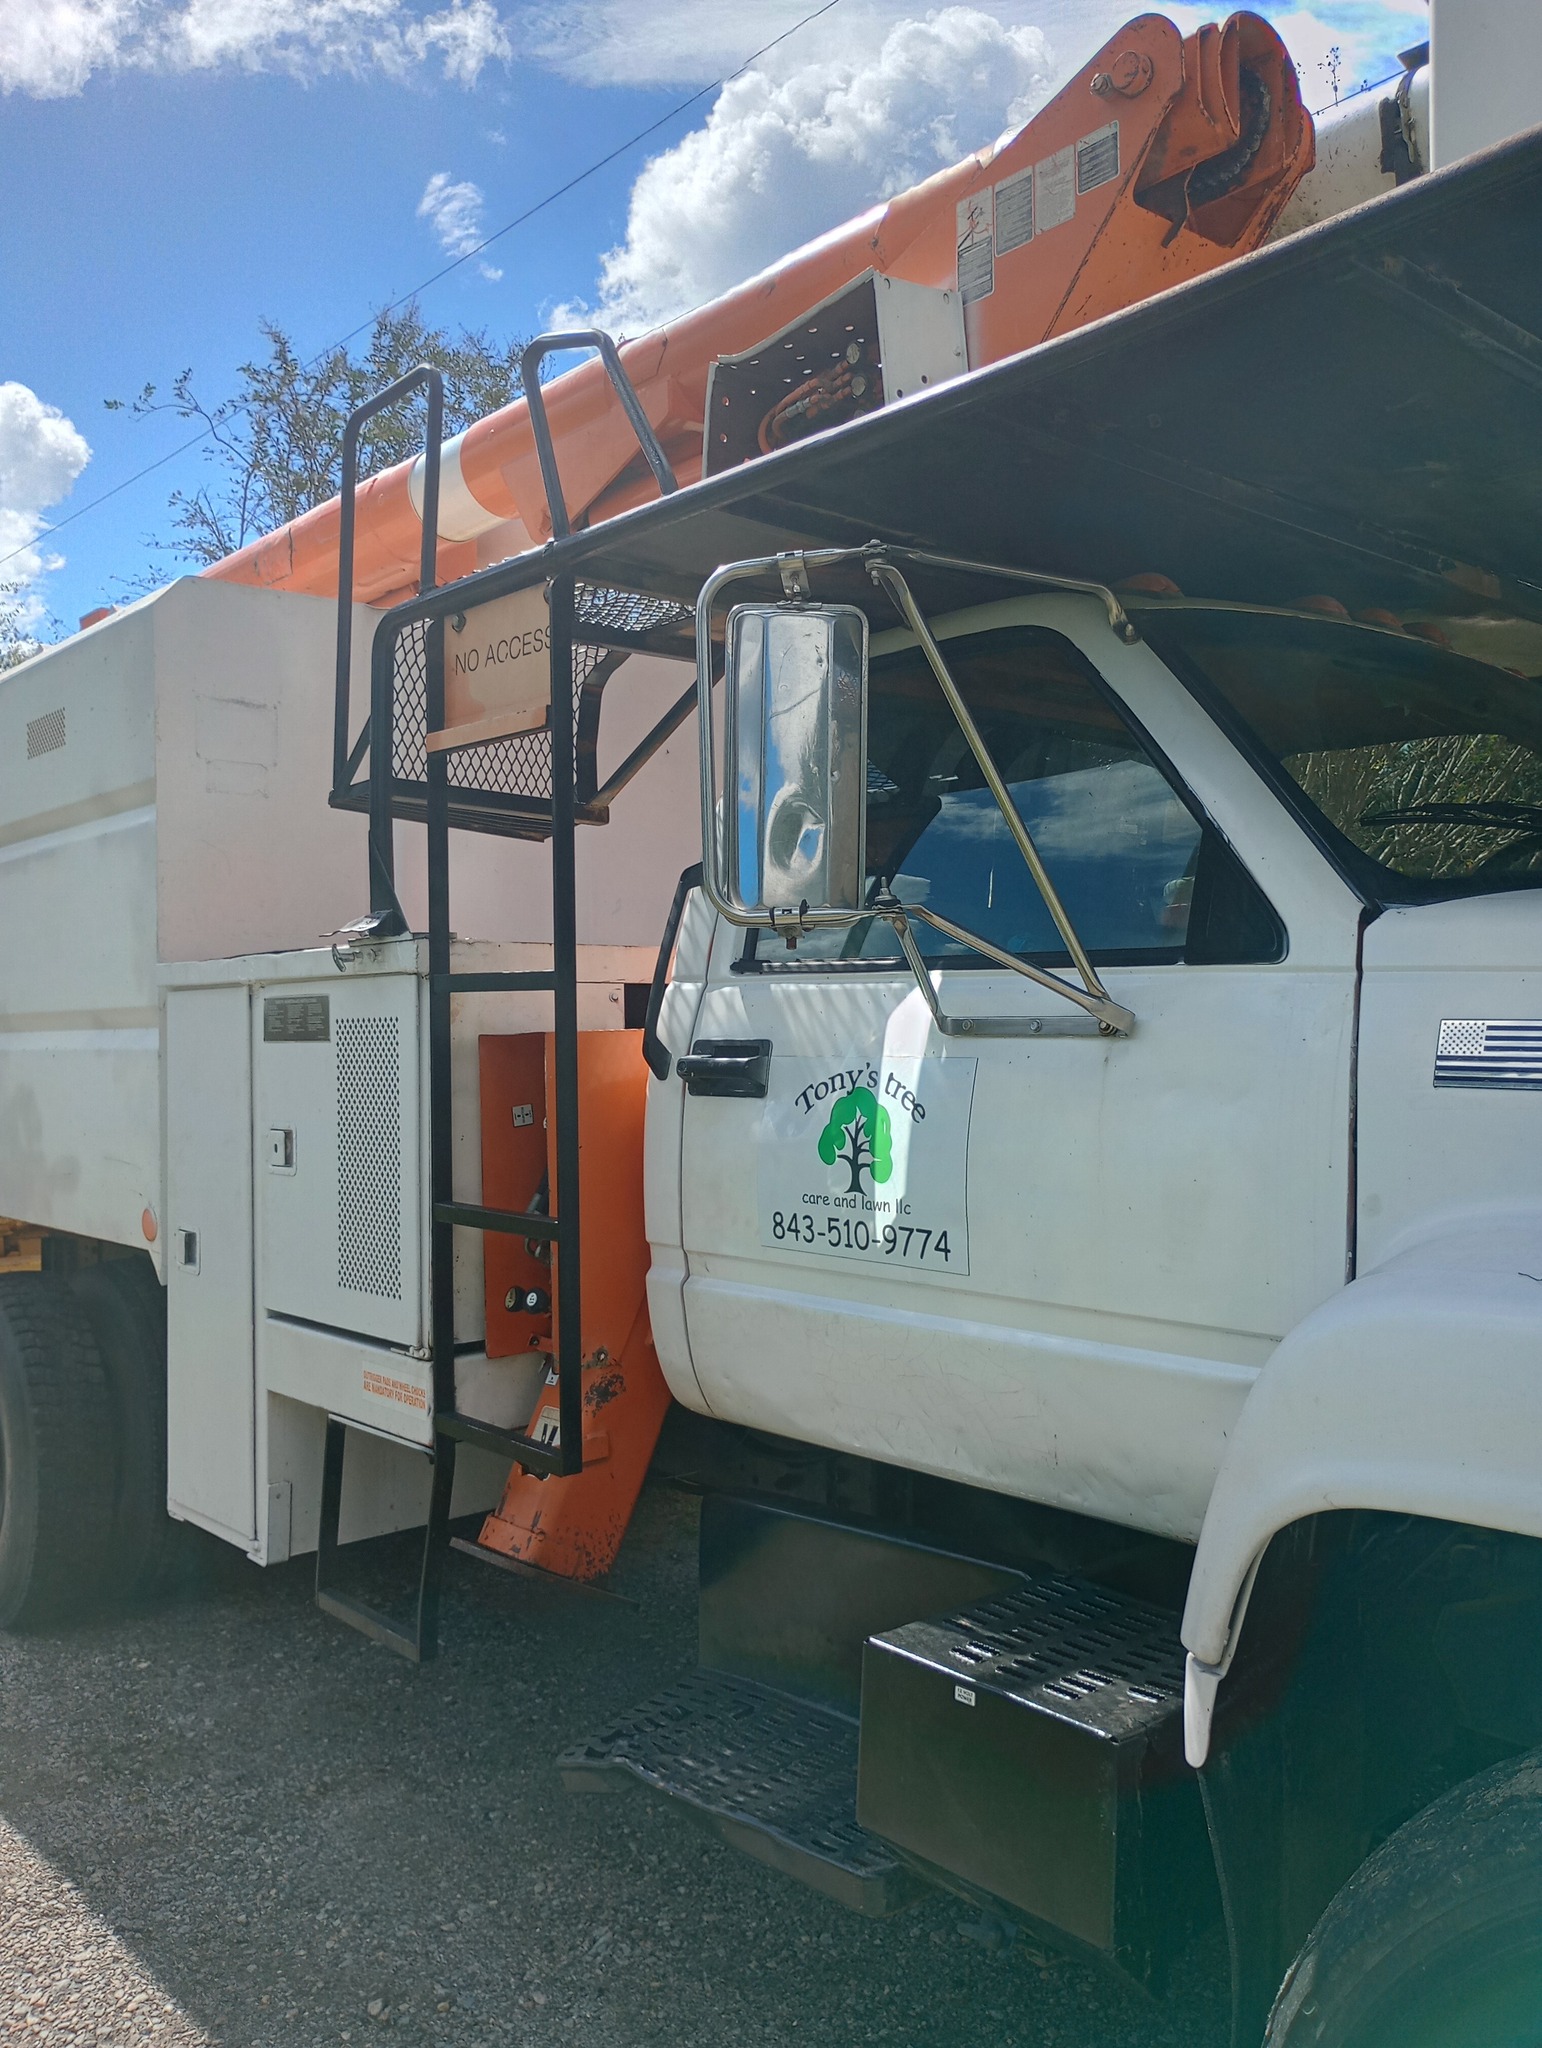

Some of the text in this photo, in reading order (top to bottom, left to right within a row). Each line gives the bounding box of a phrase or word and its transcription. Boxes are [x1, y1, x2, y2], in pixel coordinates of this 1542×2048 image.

[455, 648, 479, 676] NO
[795, 1062, 926, 1124] Tony's tree
[802, 1193, 912, 1215] care and lawn llc
[772, 1211, 951, 1262] 843-510-9774
[363, 1380, 371, 1392] ARE
[395, 1390, 403, 1402] FOR
[403, 1393, 426, 1409] OPERATION
